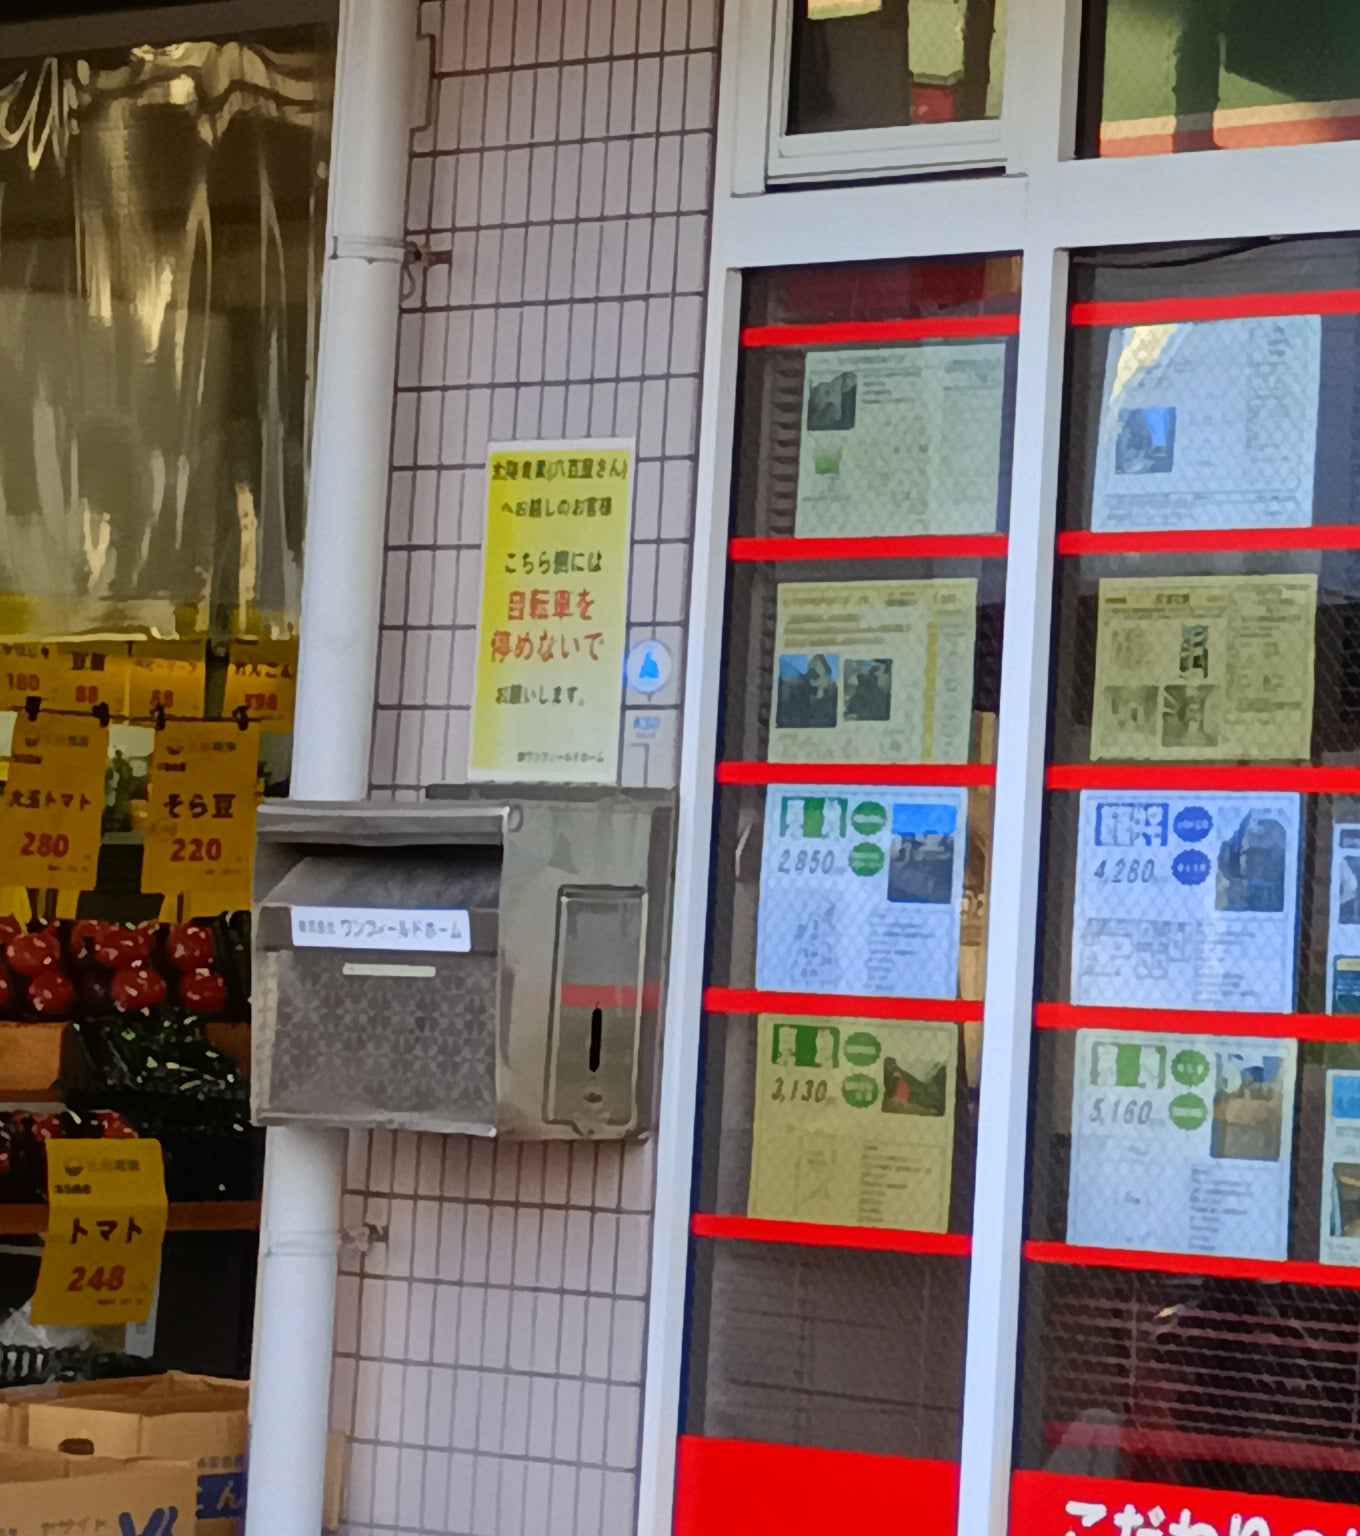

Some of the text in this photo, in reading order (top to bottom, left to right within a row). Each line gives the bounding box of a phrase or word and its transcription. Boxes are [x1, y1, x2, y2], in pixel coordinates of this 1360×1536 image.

[507, 588, 596, 622] 自転車を
[490, 629, 605, 664] 停めないで
[163, 793, 237, 820] そら豆
[19, 831, 70, 859] 280
[169, 837, 223, 863] 220
[1093, 857, 1156, 886] 4,280
[1089, 1097, 1153, 1126] 5,160
[69, 1216, 144, 1245] トマト
[66, 1265, 127, 1293] 248
